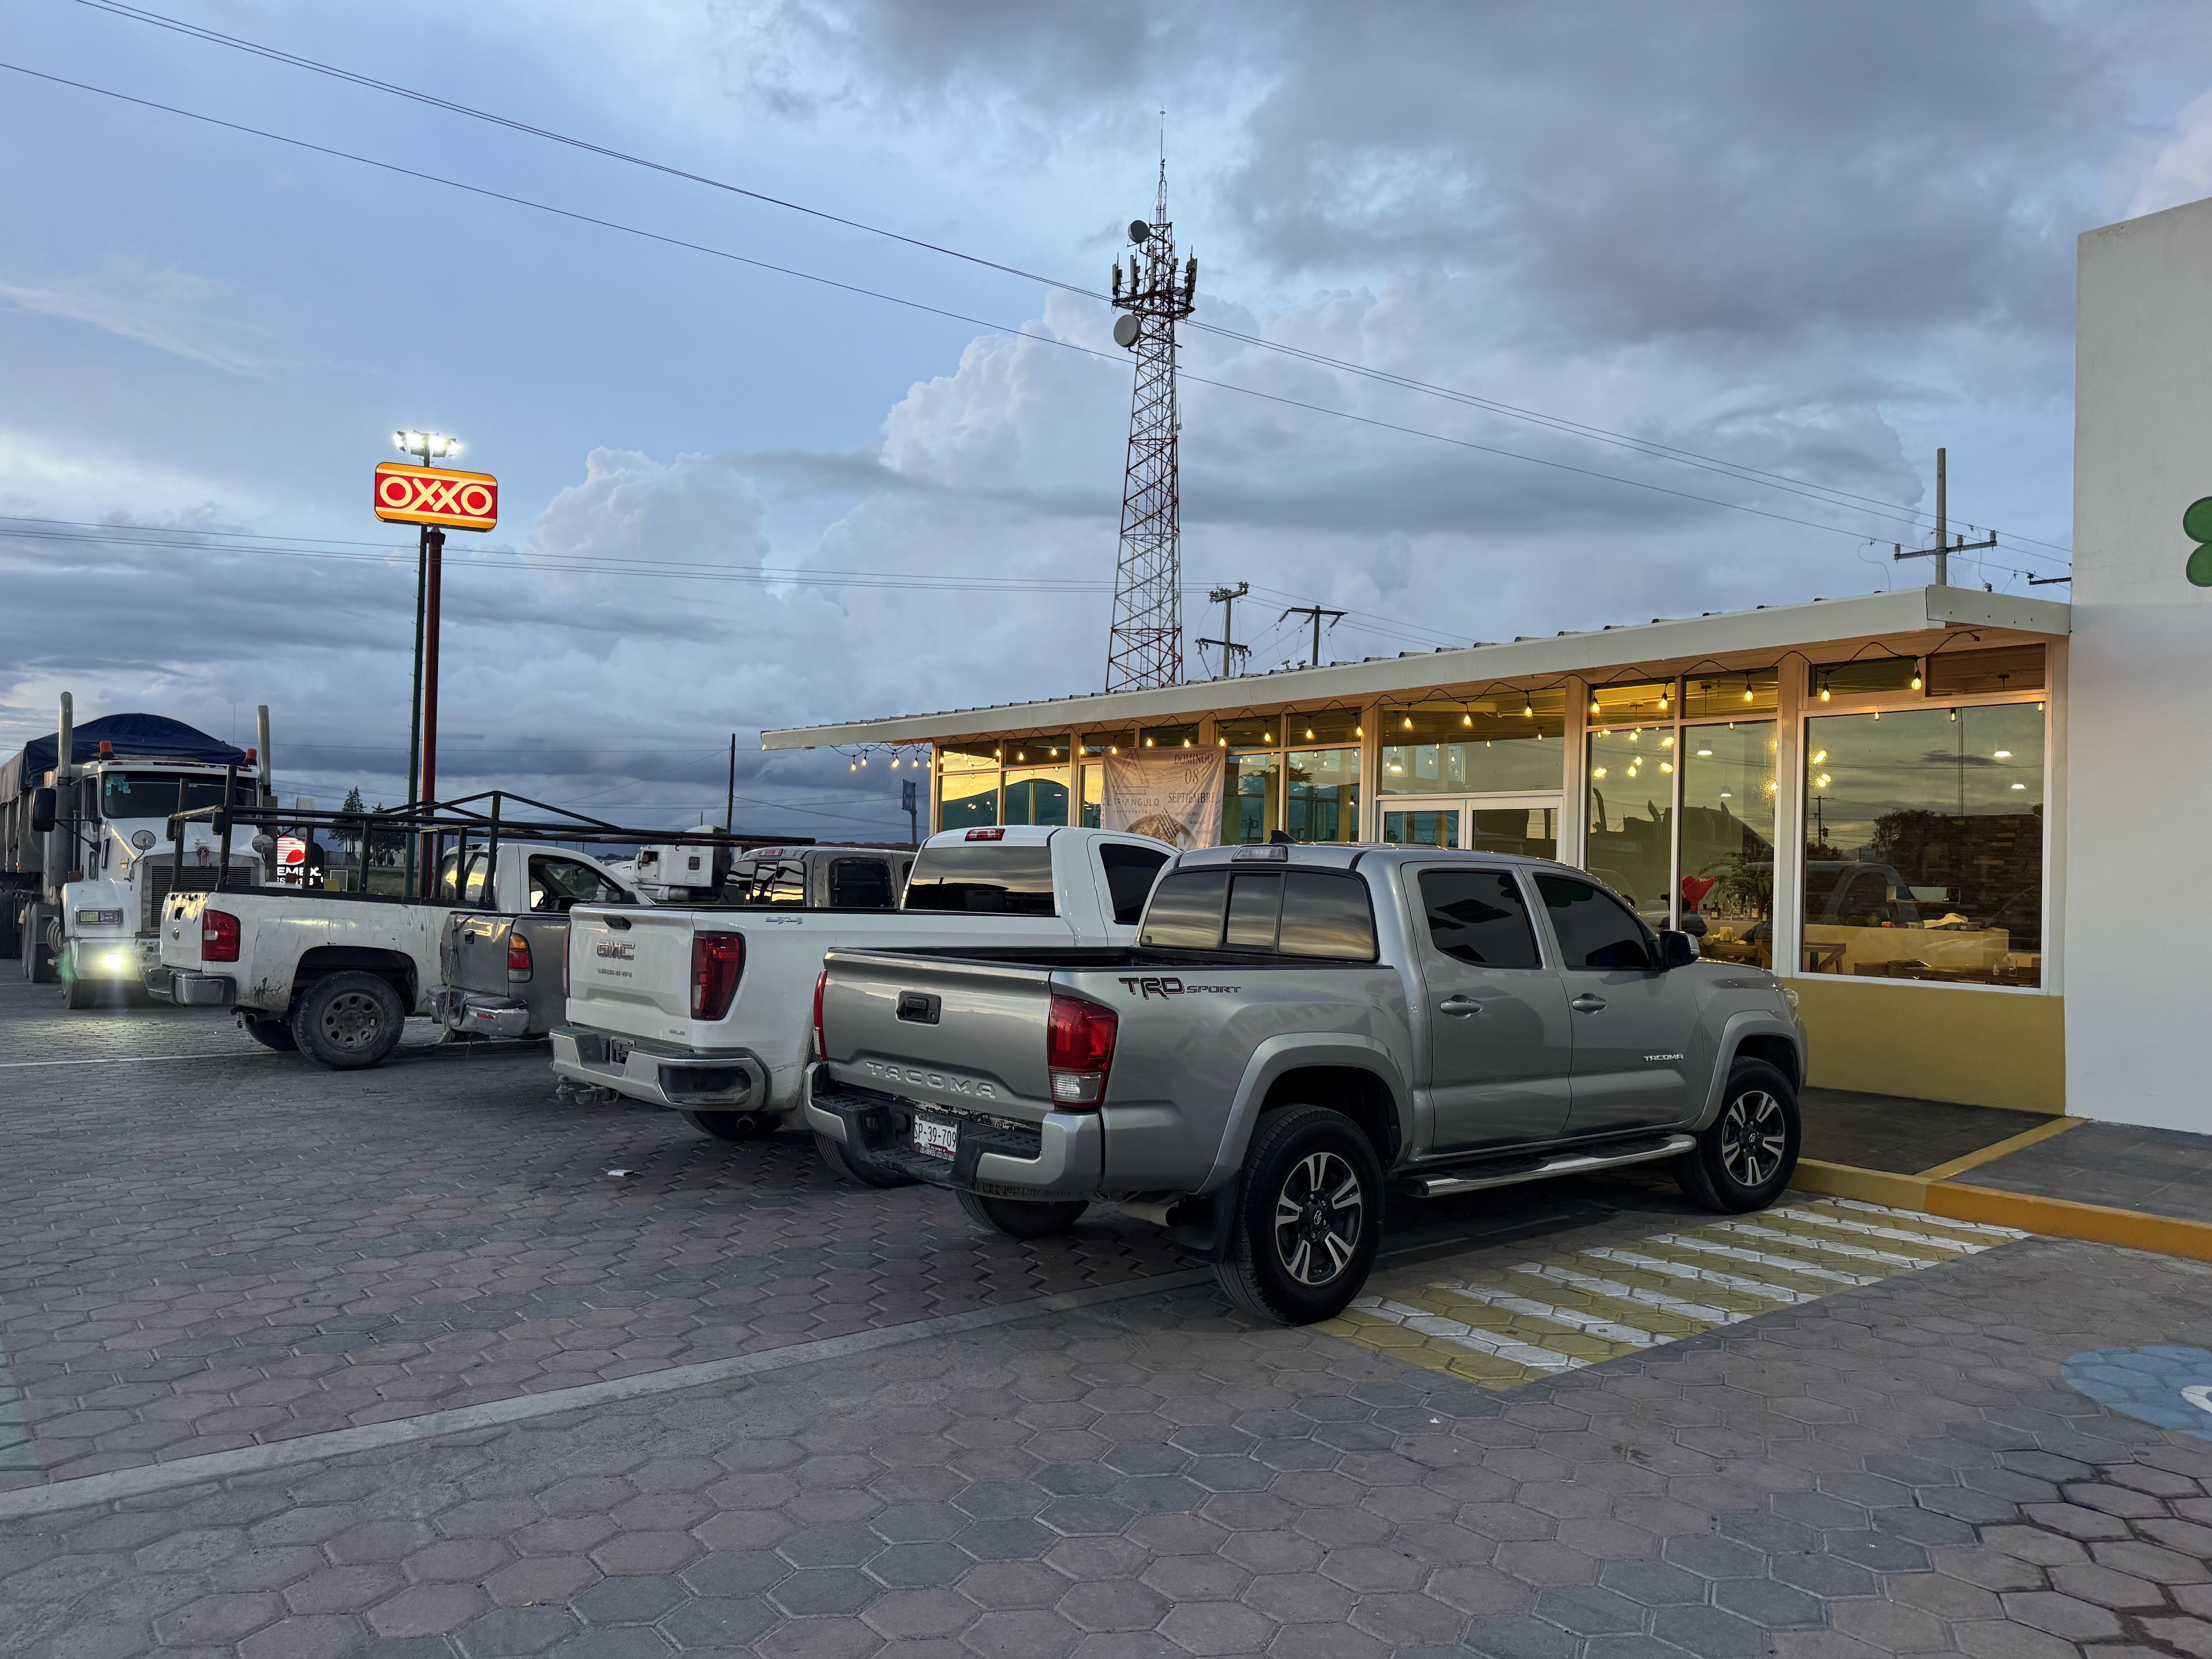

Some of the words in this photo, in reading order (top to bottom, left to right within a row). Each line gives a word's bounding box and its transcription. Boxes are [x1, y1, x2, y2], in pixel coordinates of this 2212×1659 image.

[380, 477, 493, 515] OXXO
[1175, 753, 1213, 765] DOMINGO
[1185, 768, 1199, 784] 08
[597, 941, 635, 960] GMC
[598, 968, 632, 977] SIERRA
[1118, 977, 1185, 1000] TRD
[907, 1000, 926, 1009] TOYOTA
[866, 1061, 995, 1099] TACOMA
[914, 1122, 956, 1148] SP-39-709
